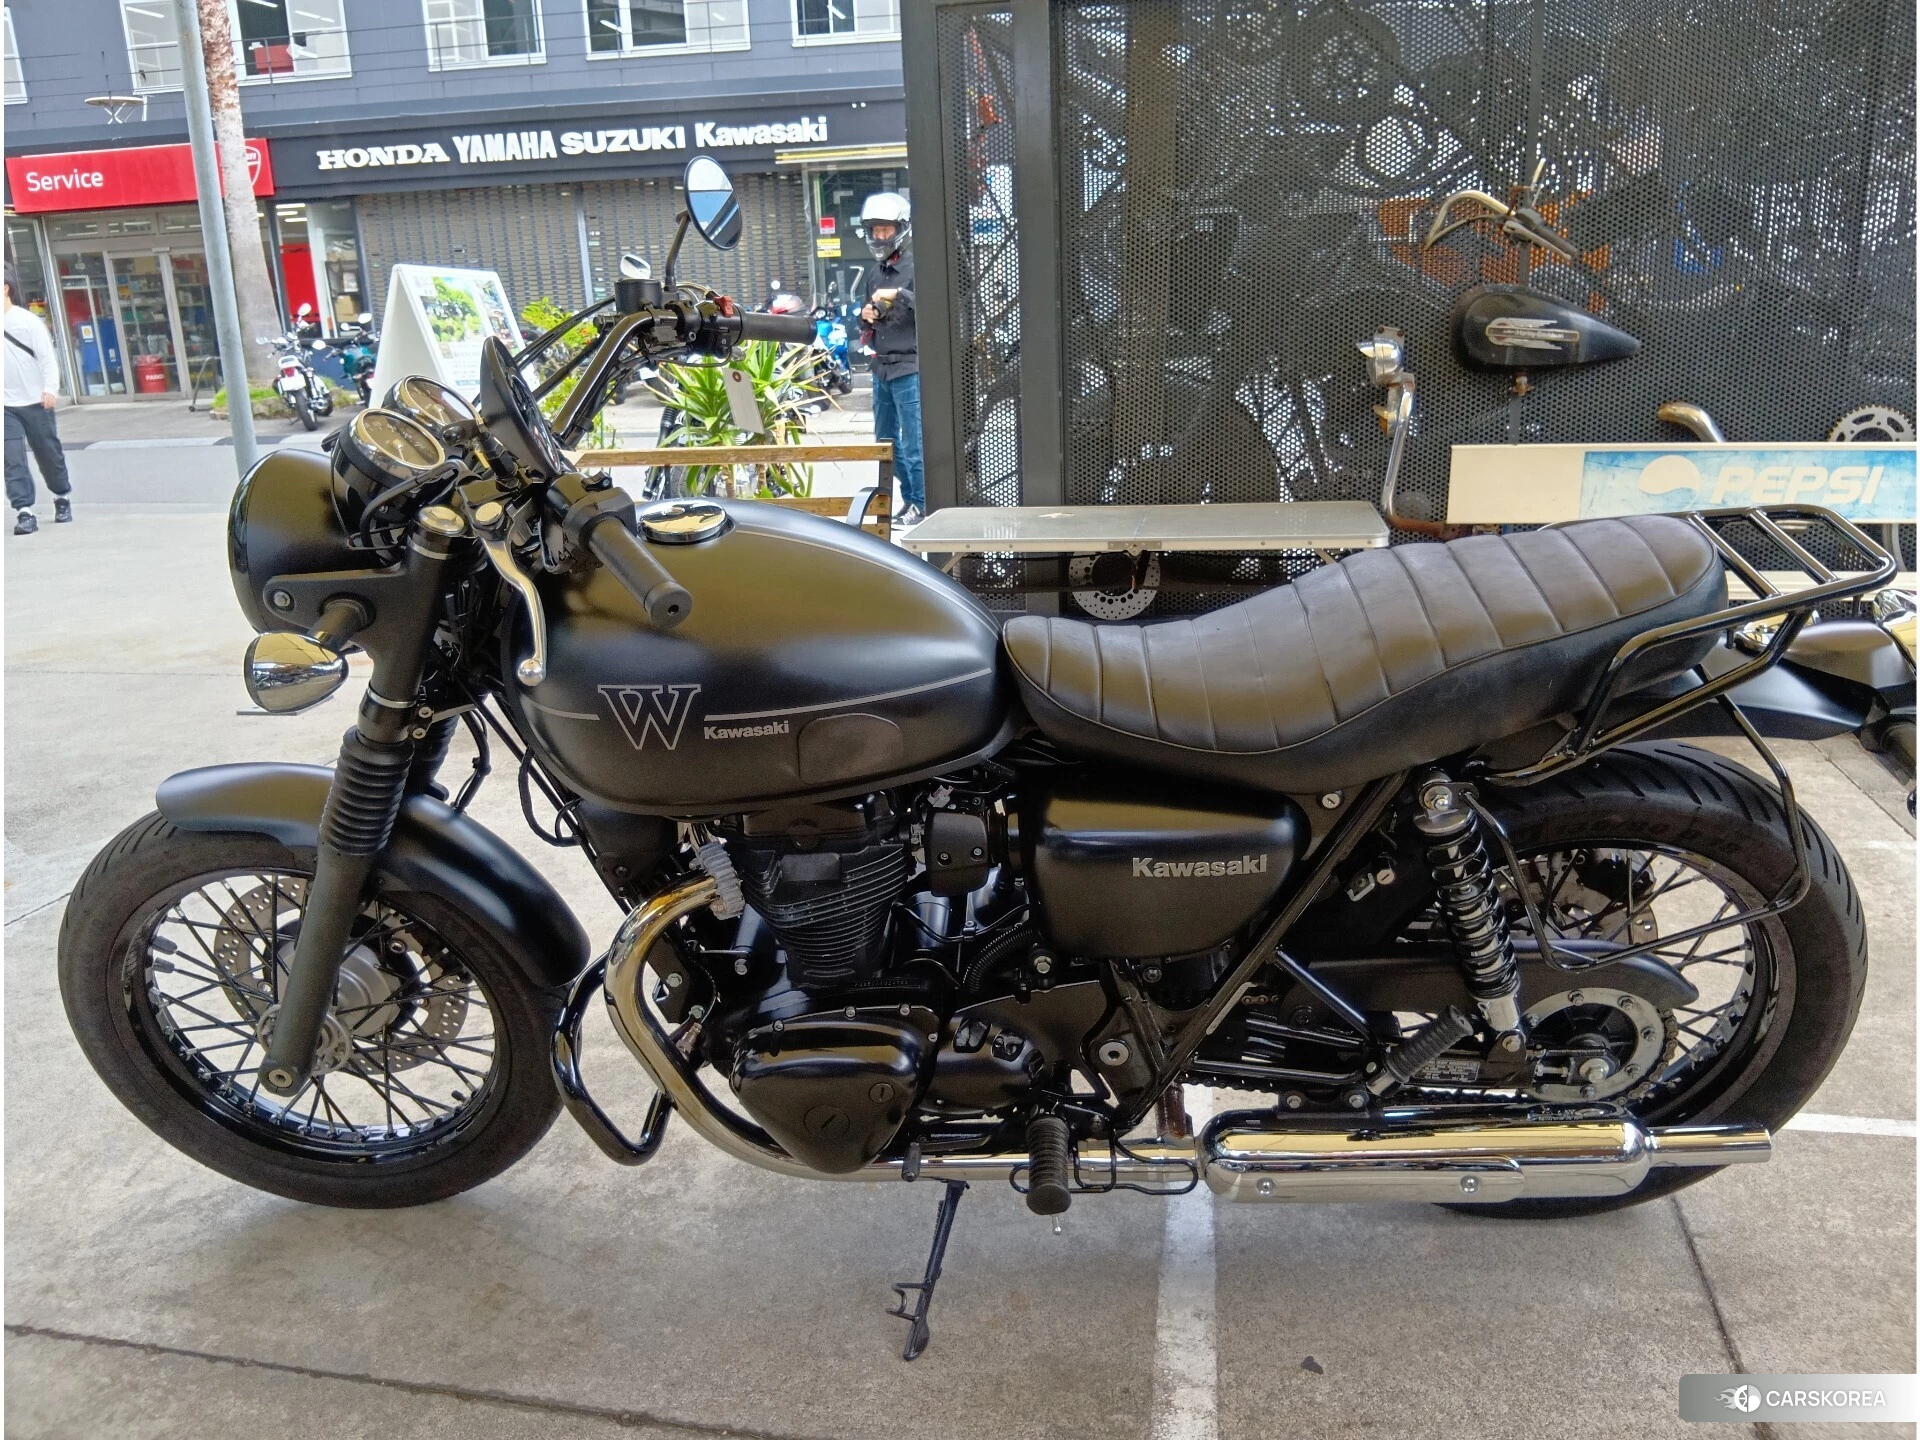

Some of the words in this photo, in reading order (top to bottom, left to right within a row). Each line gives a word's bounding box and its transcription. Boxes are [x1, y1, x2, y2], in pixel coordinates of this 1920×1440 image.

[316, 142, 450, 169] HONDA
[452, 130, 557, 163] YAMAHA
[560, 126, 686, 154] SUZUKI
[694, 116, 828, 148] Kawasaki
[26, 168, 103, 191] Service
[1710, 466, 1885, 504] PEPSI
[598, 685, 701, 750] W
[704, 720, 790, 739] Kawasaki
[1132, 854, 1267, 877] Kawasaki
